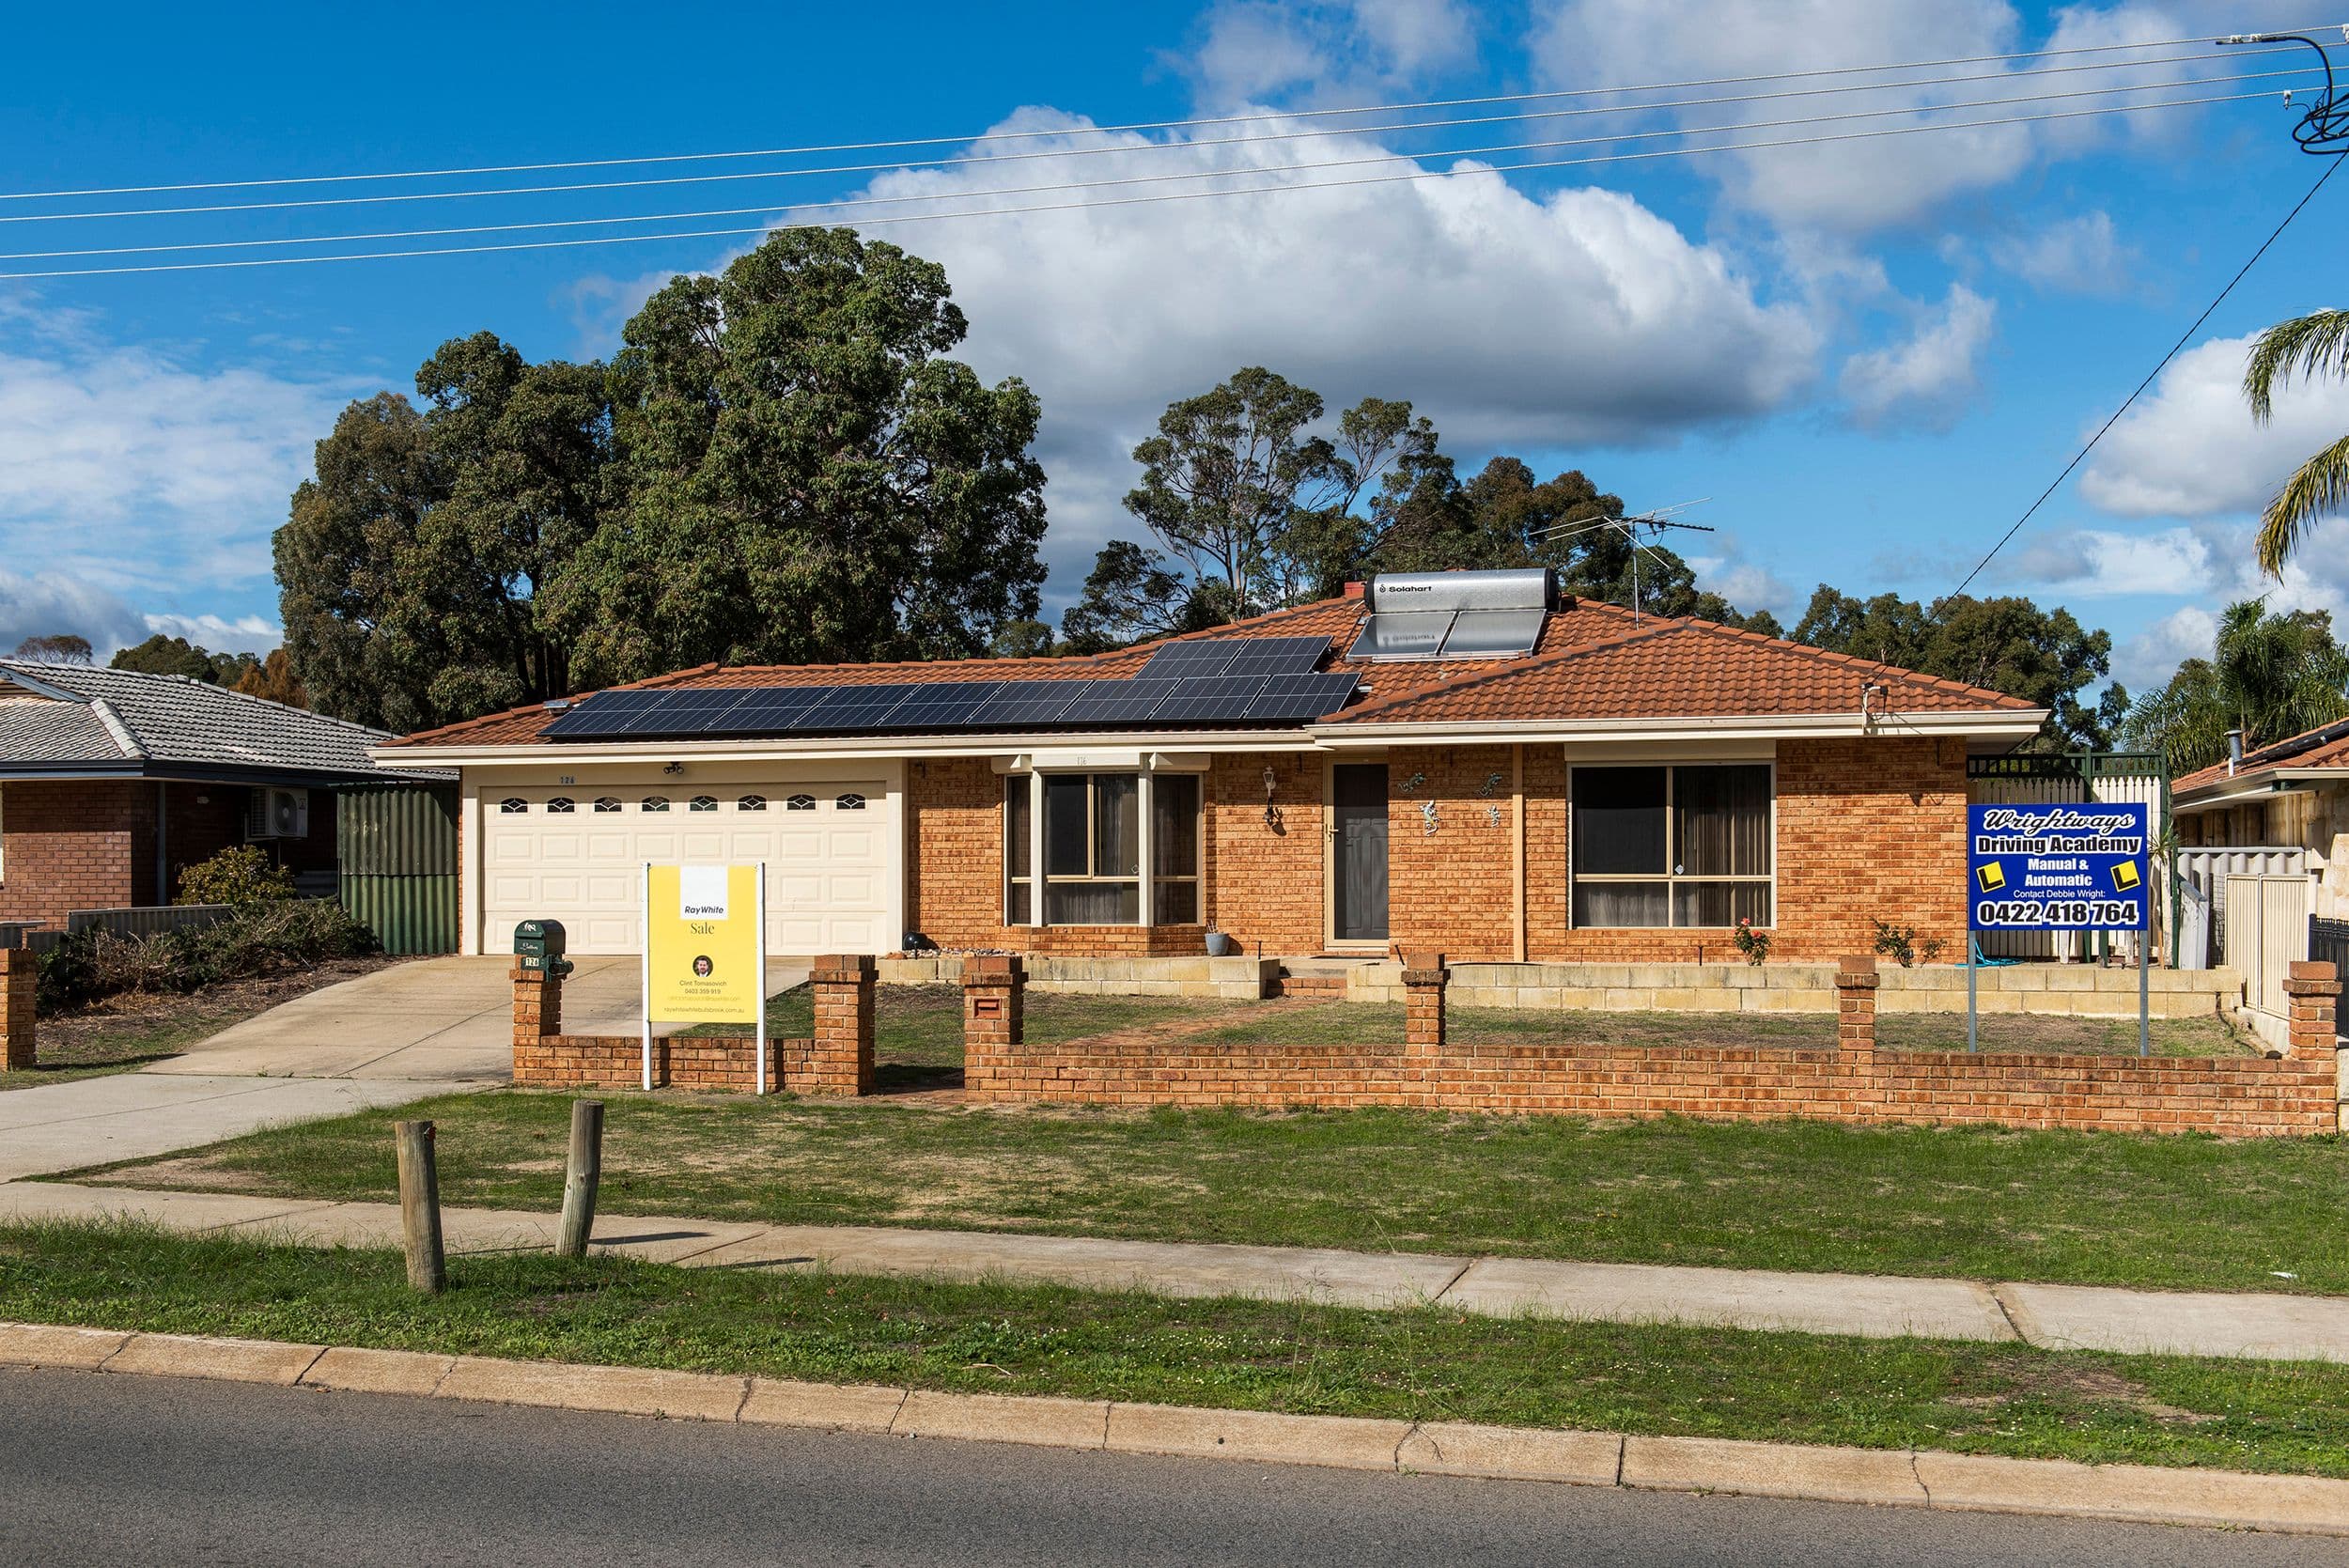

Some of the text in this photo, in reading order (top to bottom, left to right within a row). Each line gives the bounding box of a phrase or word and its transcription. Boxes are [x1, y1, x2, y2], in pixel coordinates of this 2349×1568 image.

[1983, 809, 2135, 835] Wrightways
[1977, 836, 2140, 855] Driving Academy
[2028, 859, 2089, 871] Manual &
[2025, 875, 2092, 887] Automatic
[2014, 890, 2106, 900] Contact Debbie Wright:
[1979, 902, 2137, 924] 0422 418 764
[691, 922, 714, 935] Sale
